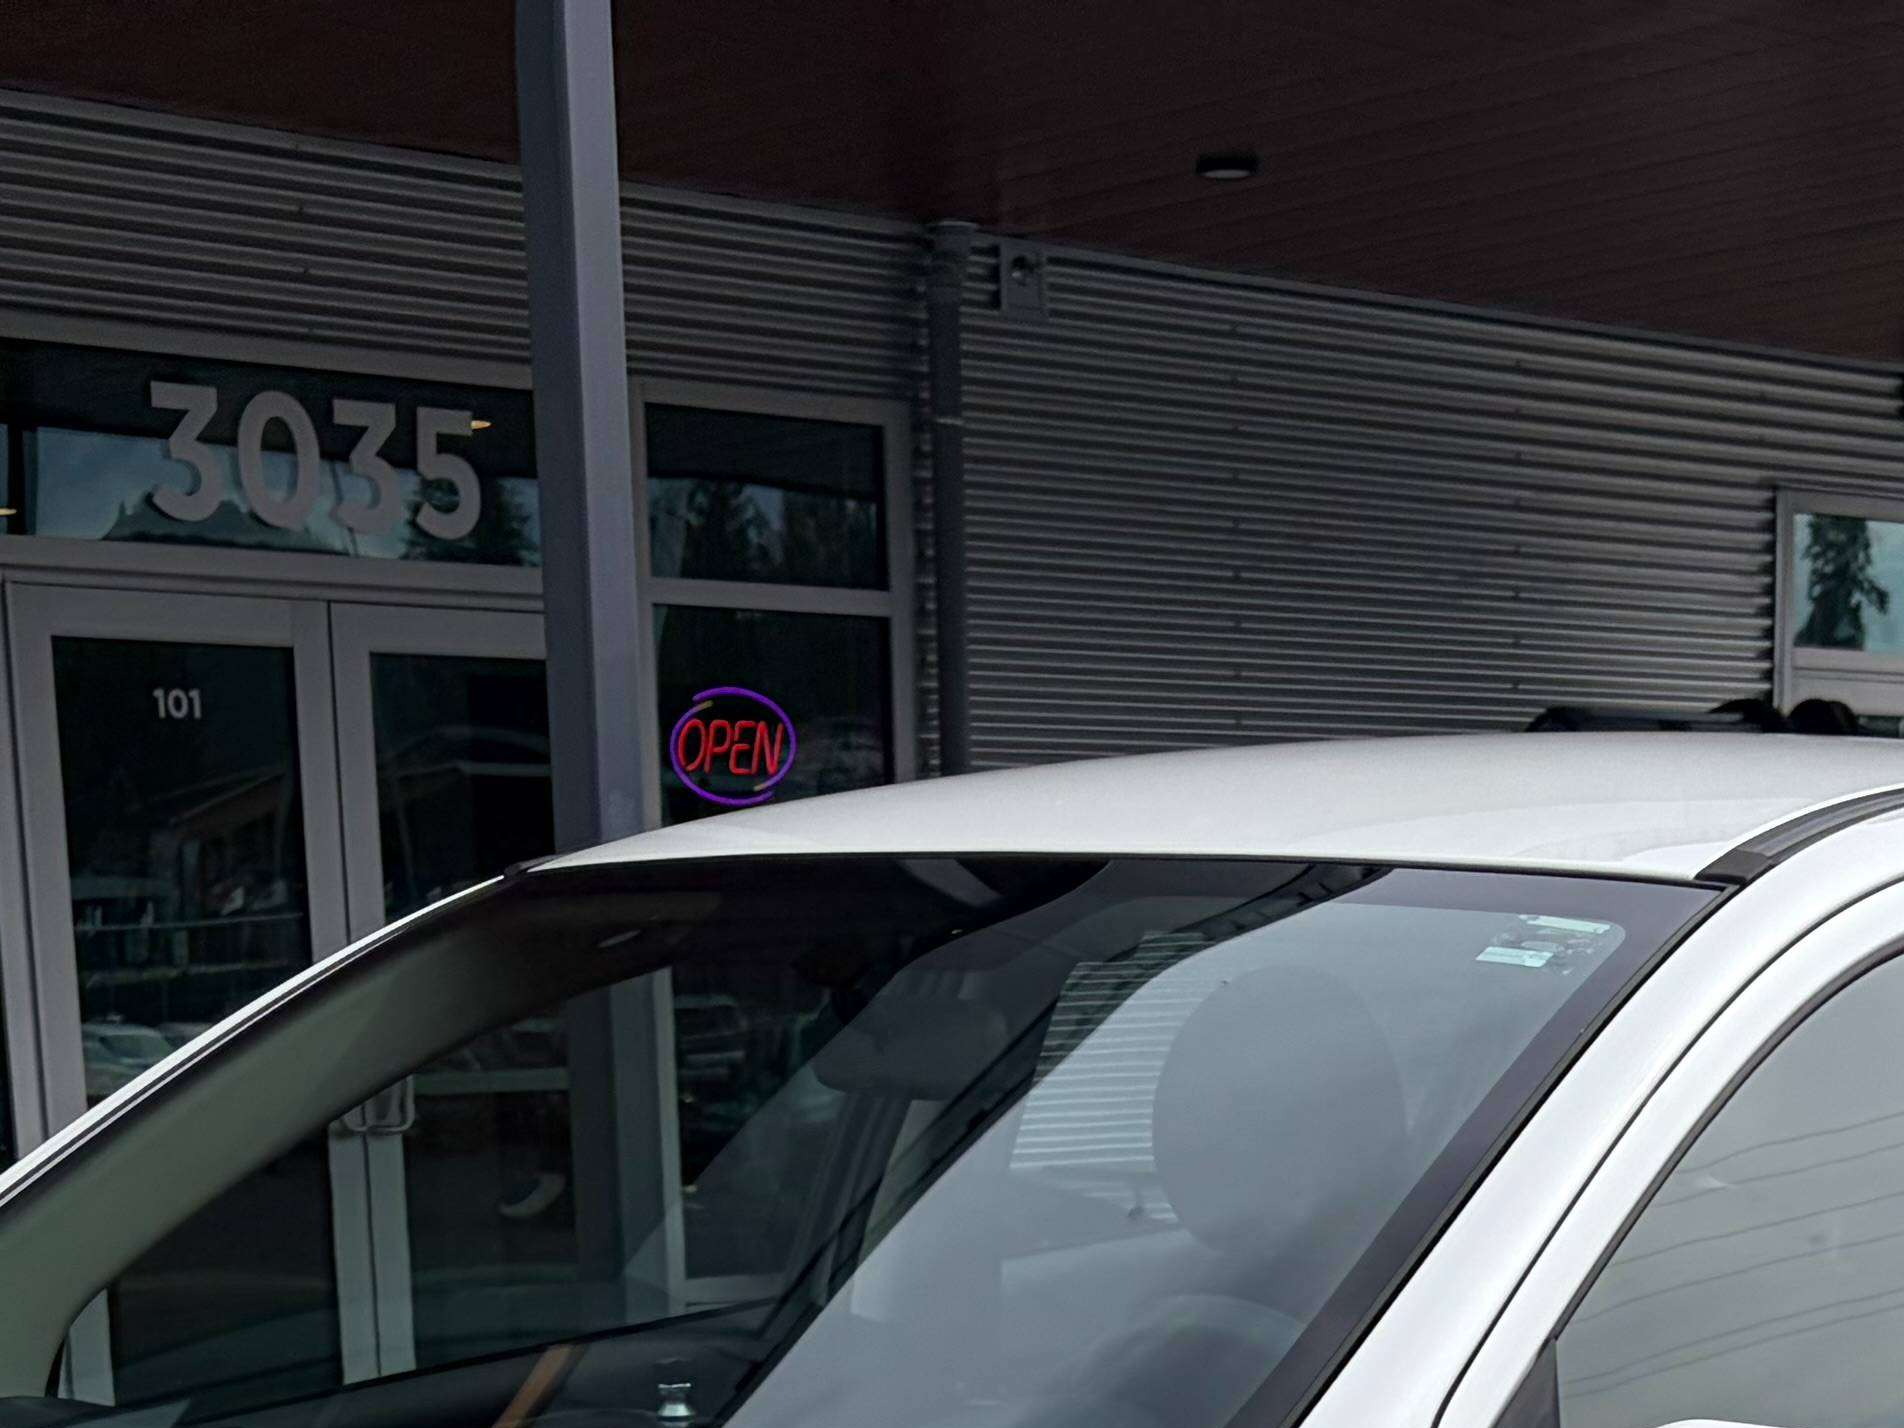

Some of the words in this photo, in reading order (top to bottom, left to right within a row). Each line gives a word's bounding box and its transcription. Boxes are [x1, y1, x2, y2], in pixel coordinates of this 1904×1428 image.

[150, 381, 482, 540] 3035
[152, 687, 202, 719] 101
[678, 718, 785, 776] OPEN
